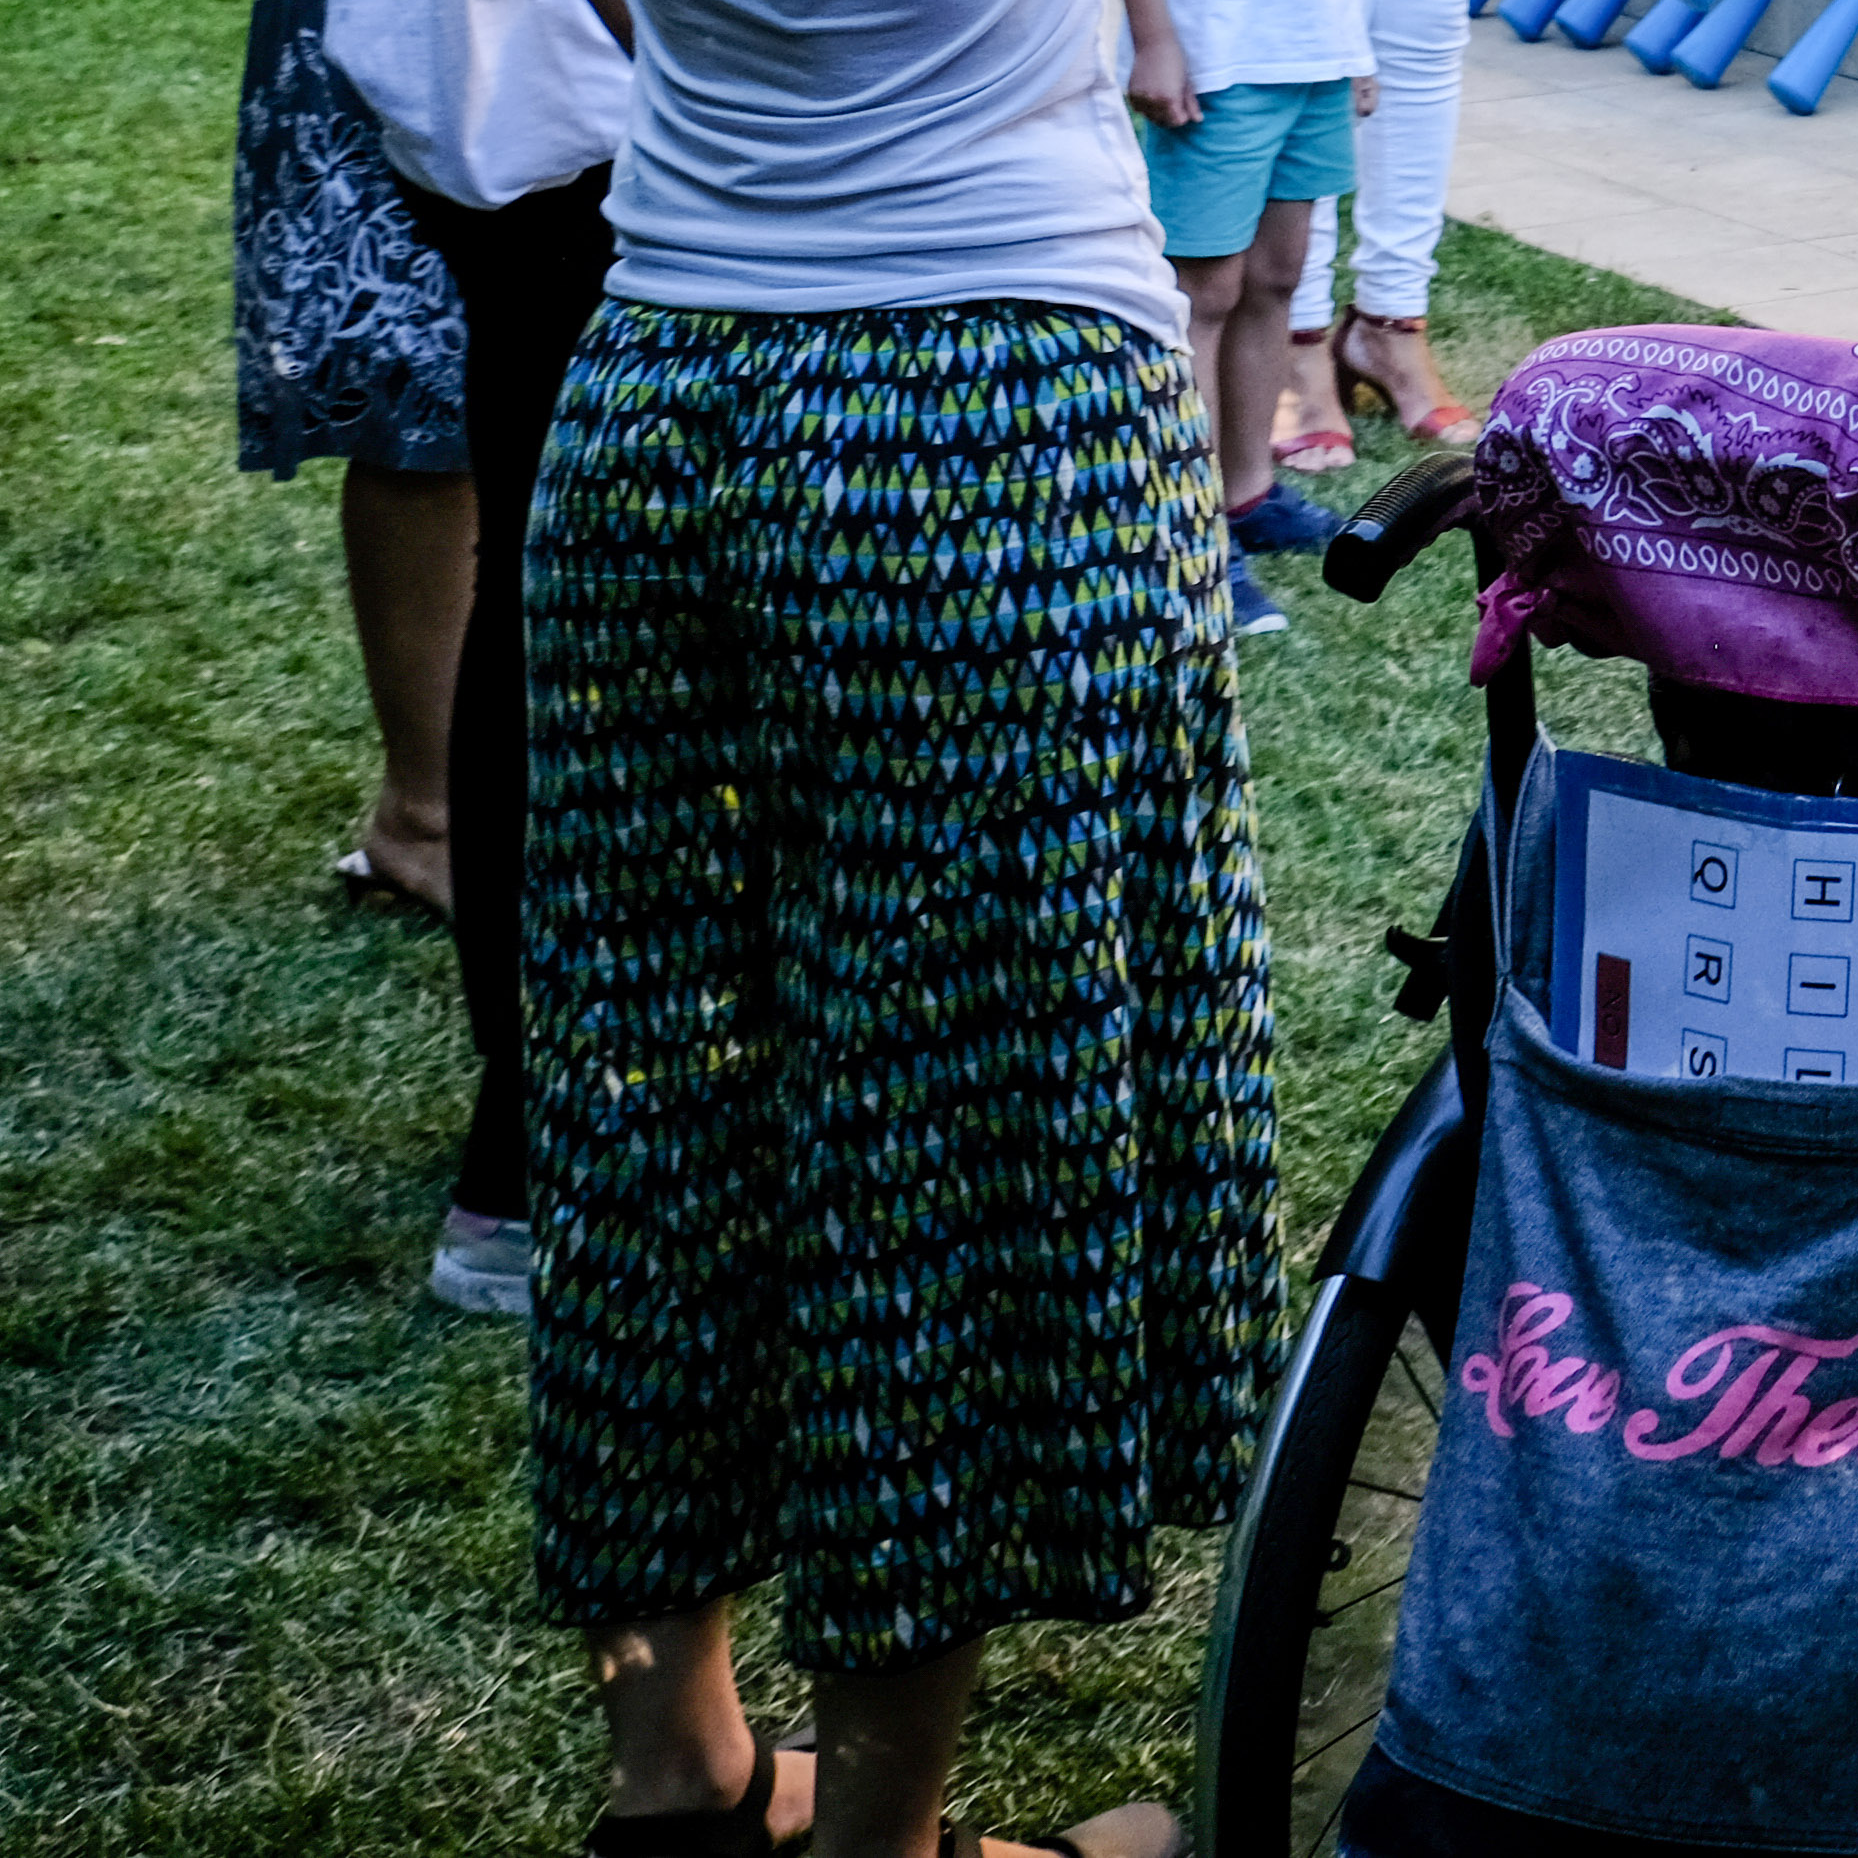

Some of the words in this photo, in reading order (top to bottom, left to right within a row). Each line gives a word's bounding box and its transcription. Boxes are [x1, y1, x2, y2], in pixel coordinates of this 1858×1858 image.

[1692, 856, 1728, 893] Q
[1804, 875, 1842, 907] H
[1694, 952, 1722, 985] R
[1800, 981, 1836, 990] I
[1689, 1046, 1717, 1079] S
